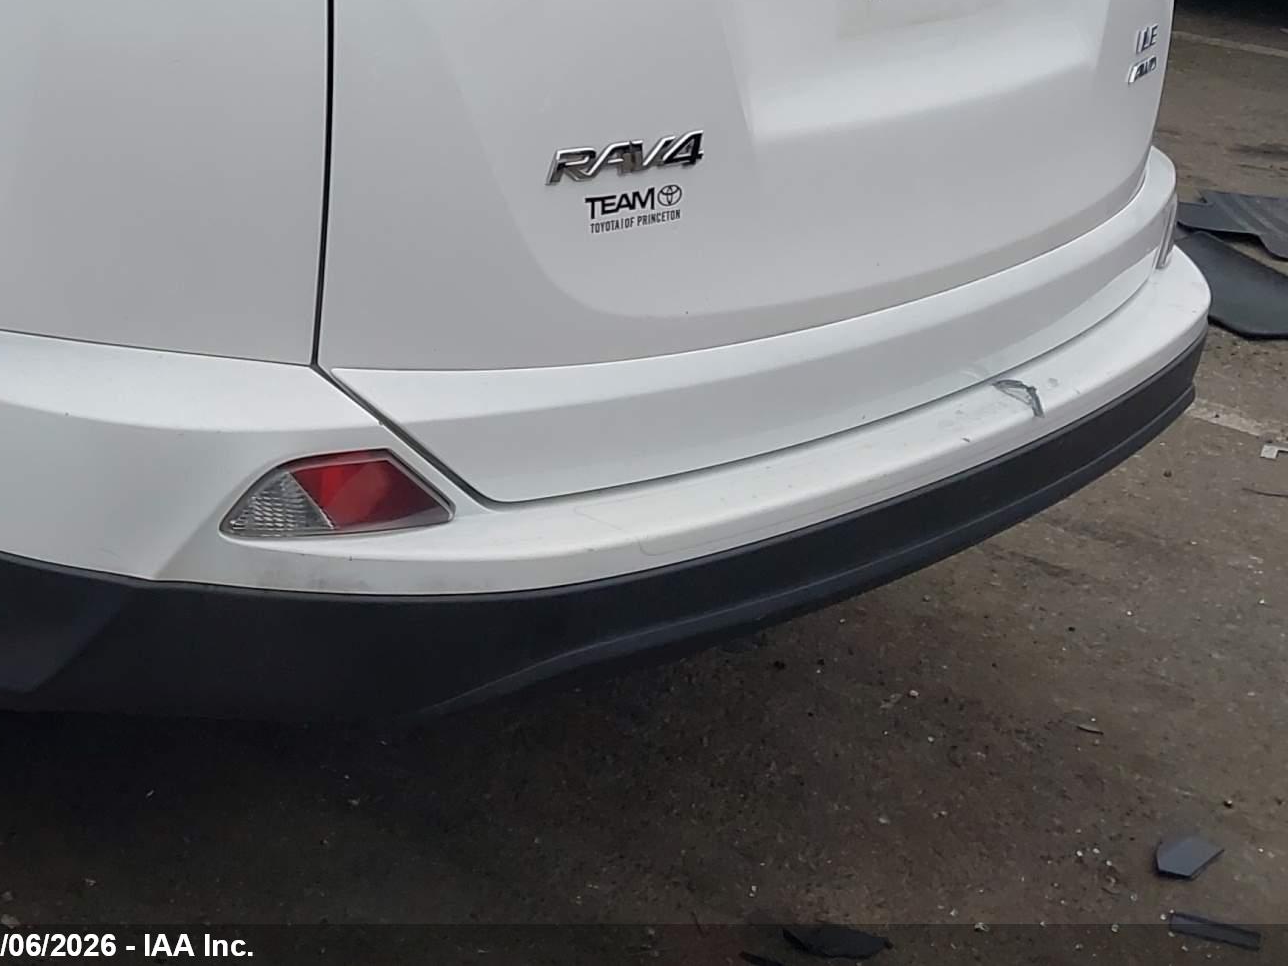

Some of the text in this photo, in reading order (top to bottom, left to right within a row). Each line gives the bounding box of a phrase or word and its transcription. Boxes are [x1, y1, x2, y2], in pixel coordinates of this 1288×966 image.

[545, 129, 704, 186] RAV4
[585, 187, 655, 220] TEAM
[637, 209, 681, 227] PRINCETON
